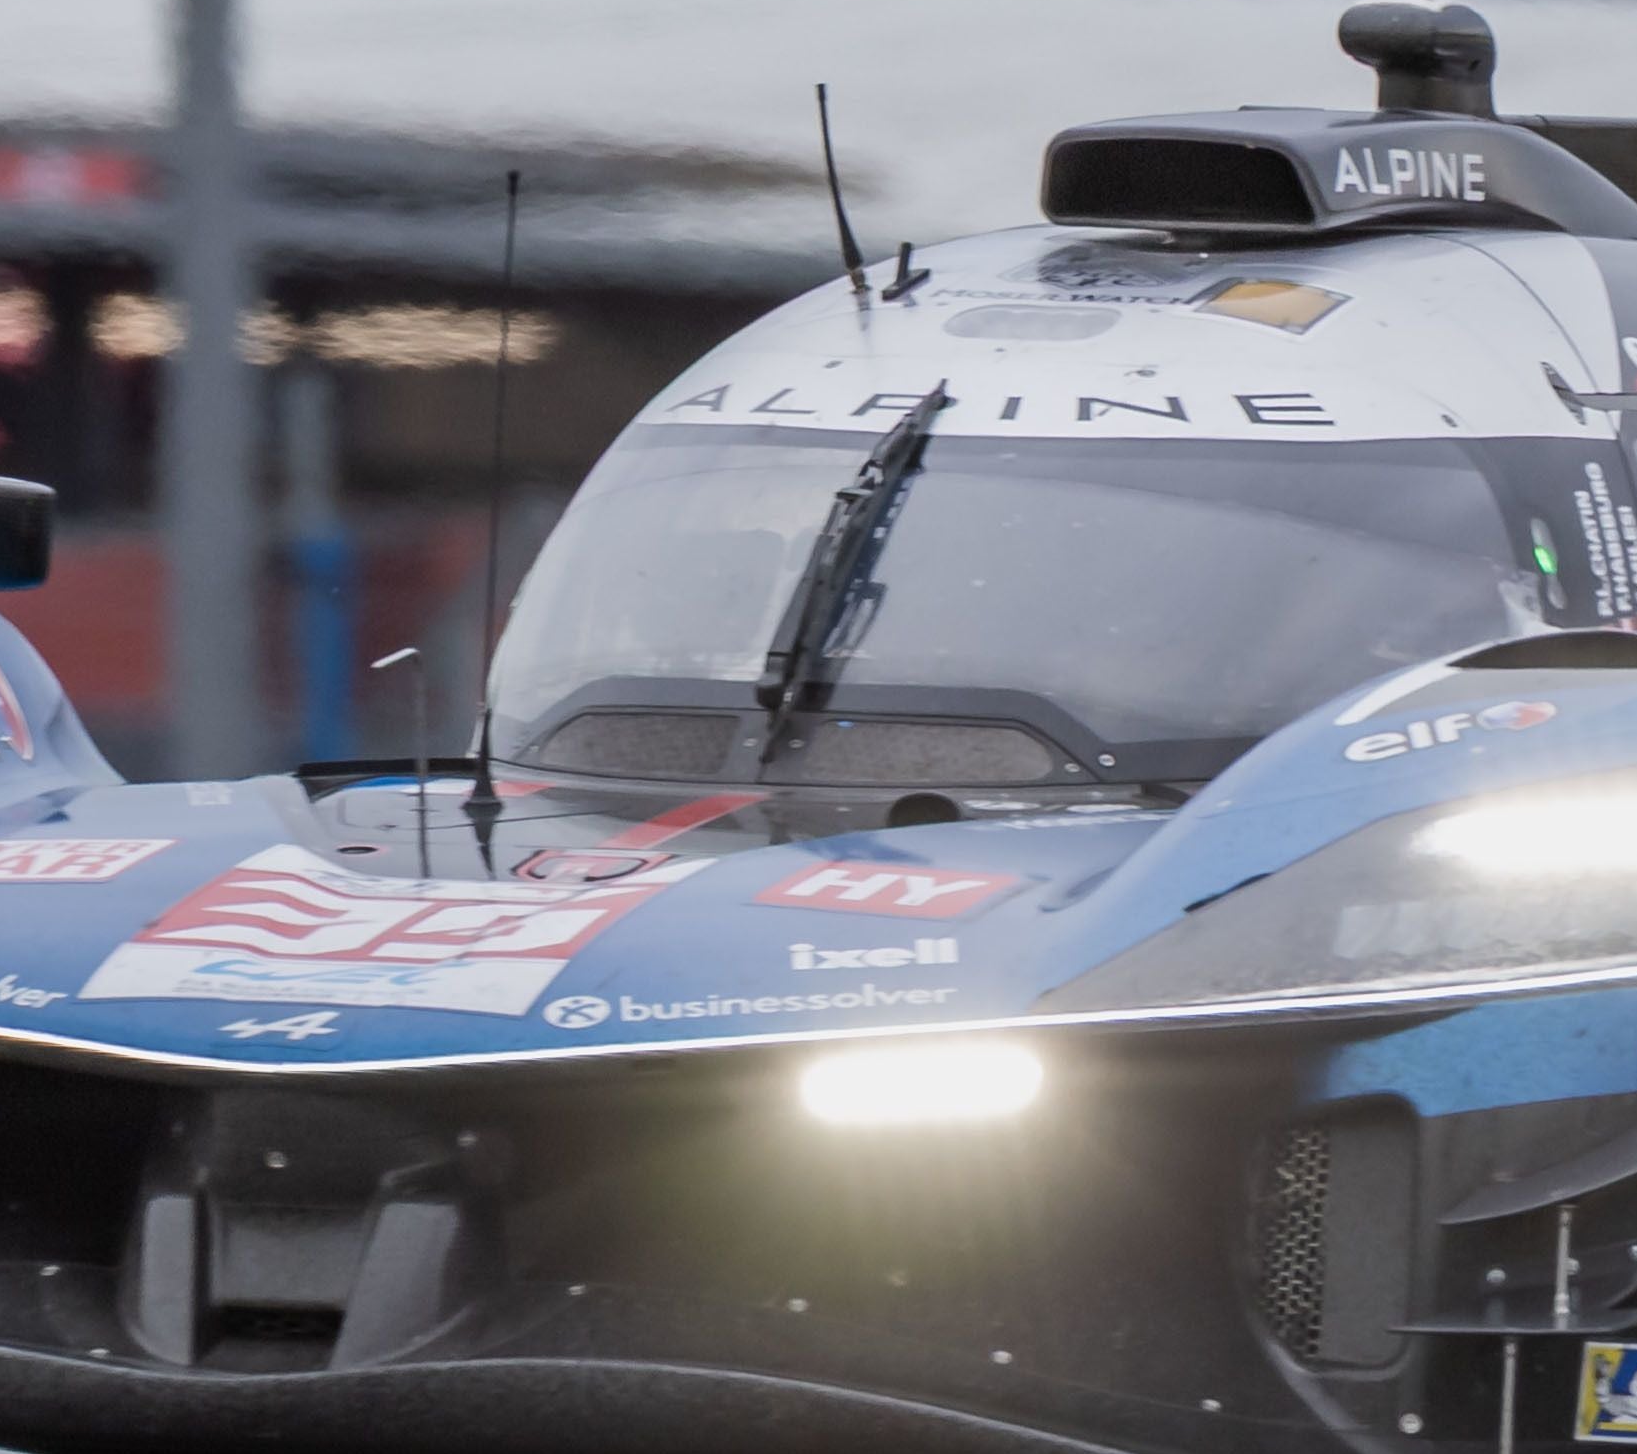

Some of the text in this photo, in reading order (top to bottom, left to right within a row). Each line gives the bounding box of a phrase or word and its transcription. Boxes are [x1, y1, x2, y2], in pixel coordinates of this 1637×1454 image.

[1335, 147, 1486, 202] ALPINE
[665, 384, 1336, 426] ALPINE
[1344, 712, 1474, 762] elf
[783, 867, 989, 906] HY
[788, 937, 960, 971] ixell
[619, 983, 957, 1023] businessolver
